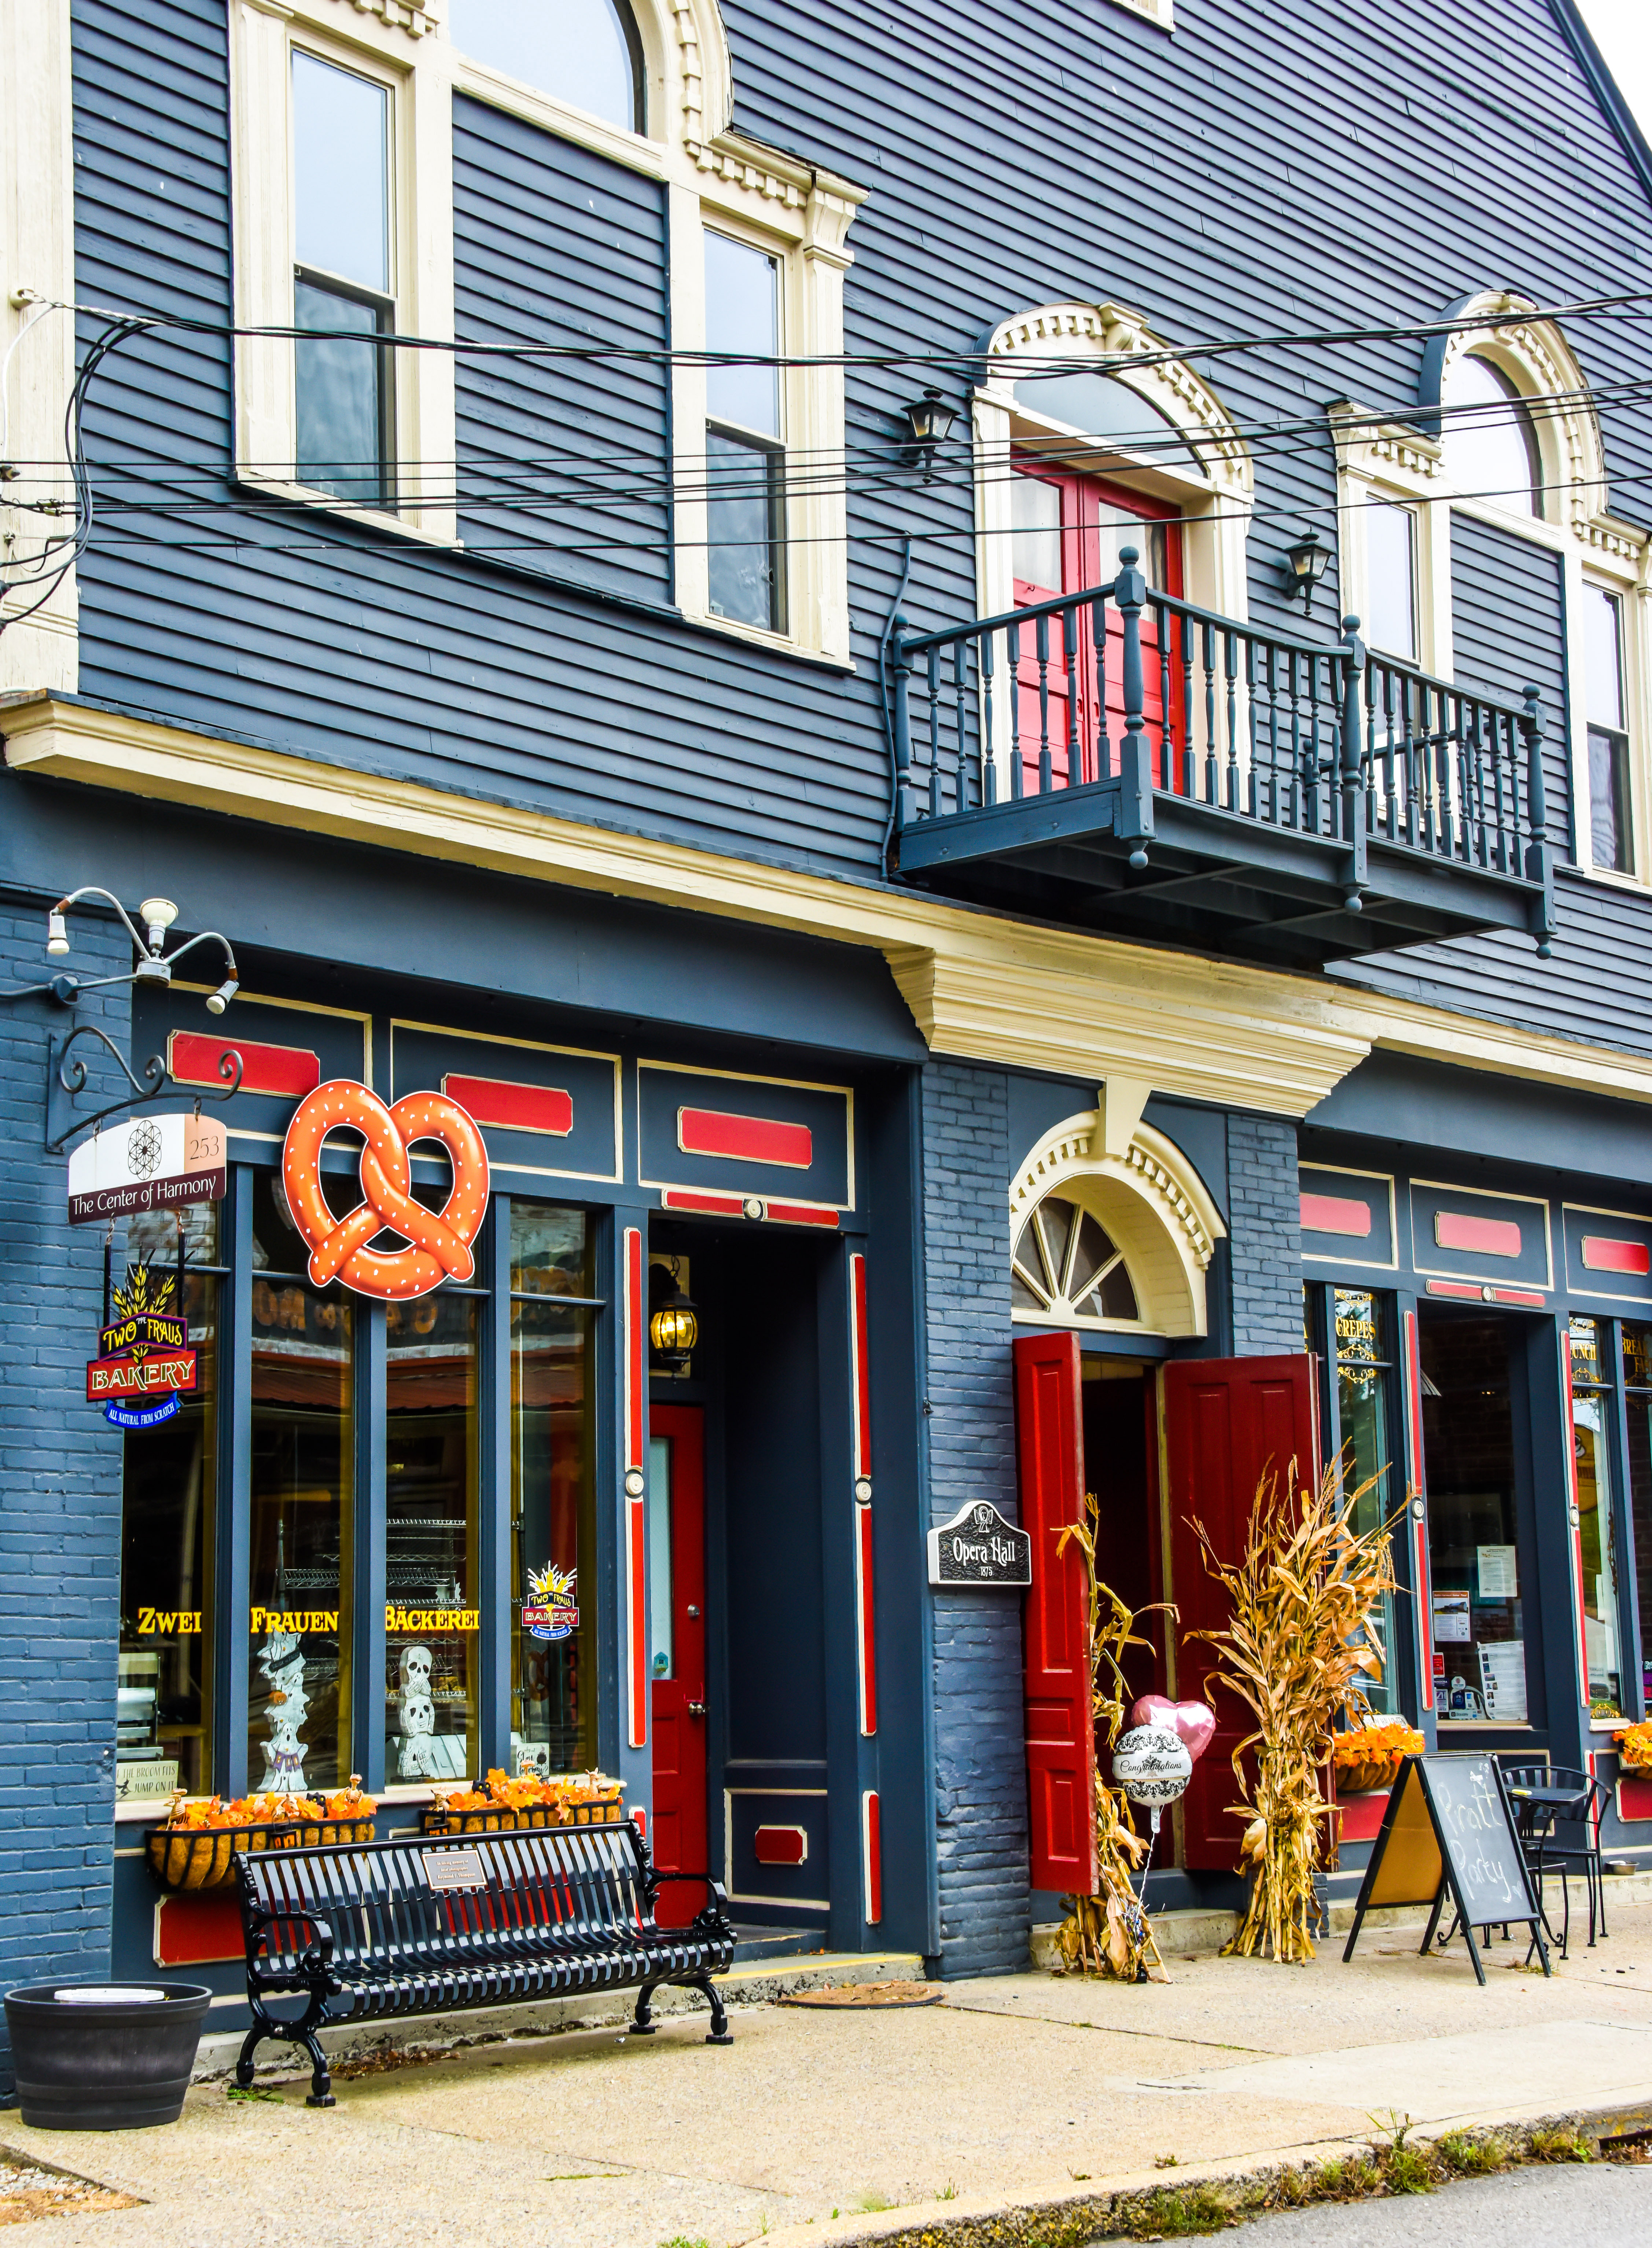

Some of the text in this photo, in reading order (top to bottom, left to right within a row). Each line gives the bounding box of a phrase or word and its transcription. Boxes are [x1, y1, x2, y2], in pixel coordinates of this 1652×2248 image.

[190, 1136, 219, 1160] 253
[73, 1176, 216, 1215] The Center of Harmony
[103, 1316, 182, 1352] TWO THE FRAUS
[1336, 1315, 1376, 1340] CRÊPES
[92, 1360, 194, 1391] BAKERY
[109, 1402, 174, 1425] ALL NATURAL FROM SCRATCH
[953, 1537, 1015, 1566] Opera Hall
[980, 1566, 992, 1577] 1875
[531, 1594, 548, 1605] TWO
[553, 1594, 571, 1607] FRAUS
[138, 1608, 202, 1634] ZWEI
[251, 1607, 339, 1633] FRAUEN
[385, 1605, 479, 1631] BÄCKEREI
[525, 1612, 577, 1624] BAKERY
[124, 1768, 134, 1778] THE
[137, 1766, 160, 1777] BROOM
[162, 1766, 176, 1776] FITS
[1120, 1760, 1182, 1775] Congratulations
[135, 1781, 174, 1793] JUMP ON IT
[1450, 1838, 1512, 1903] Party
